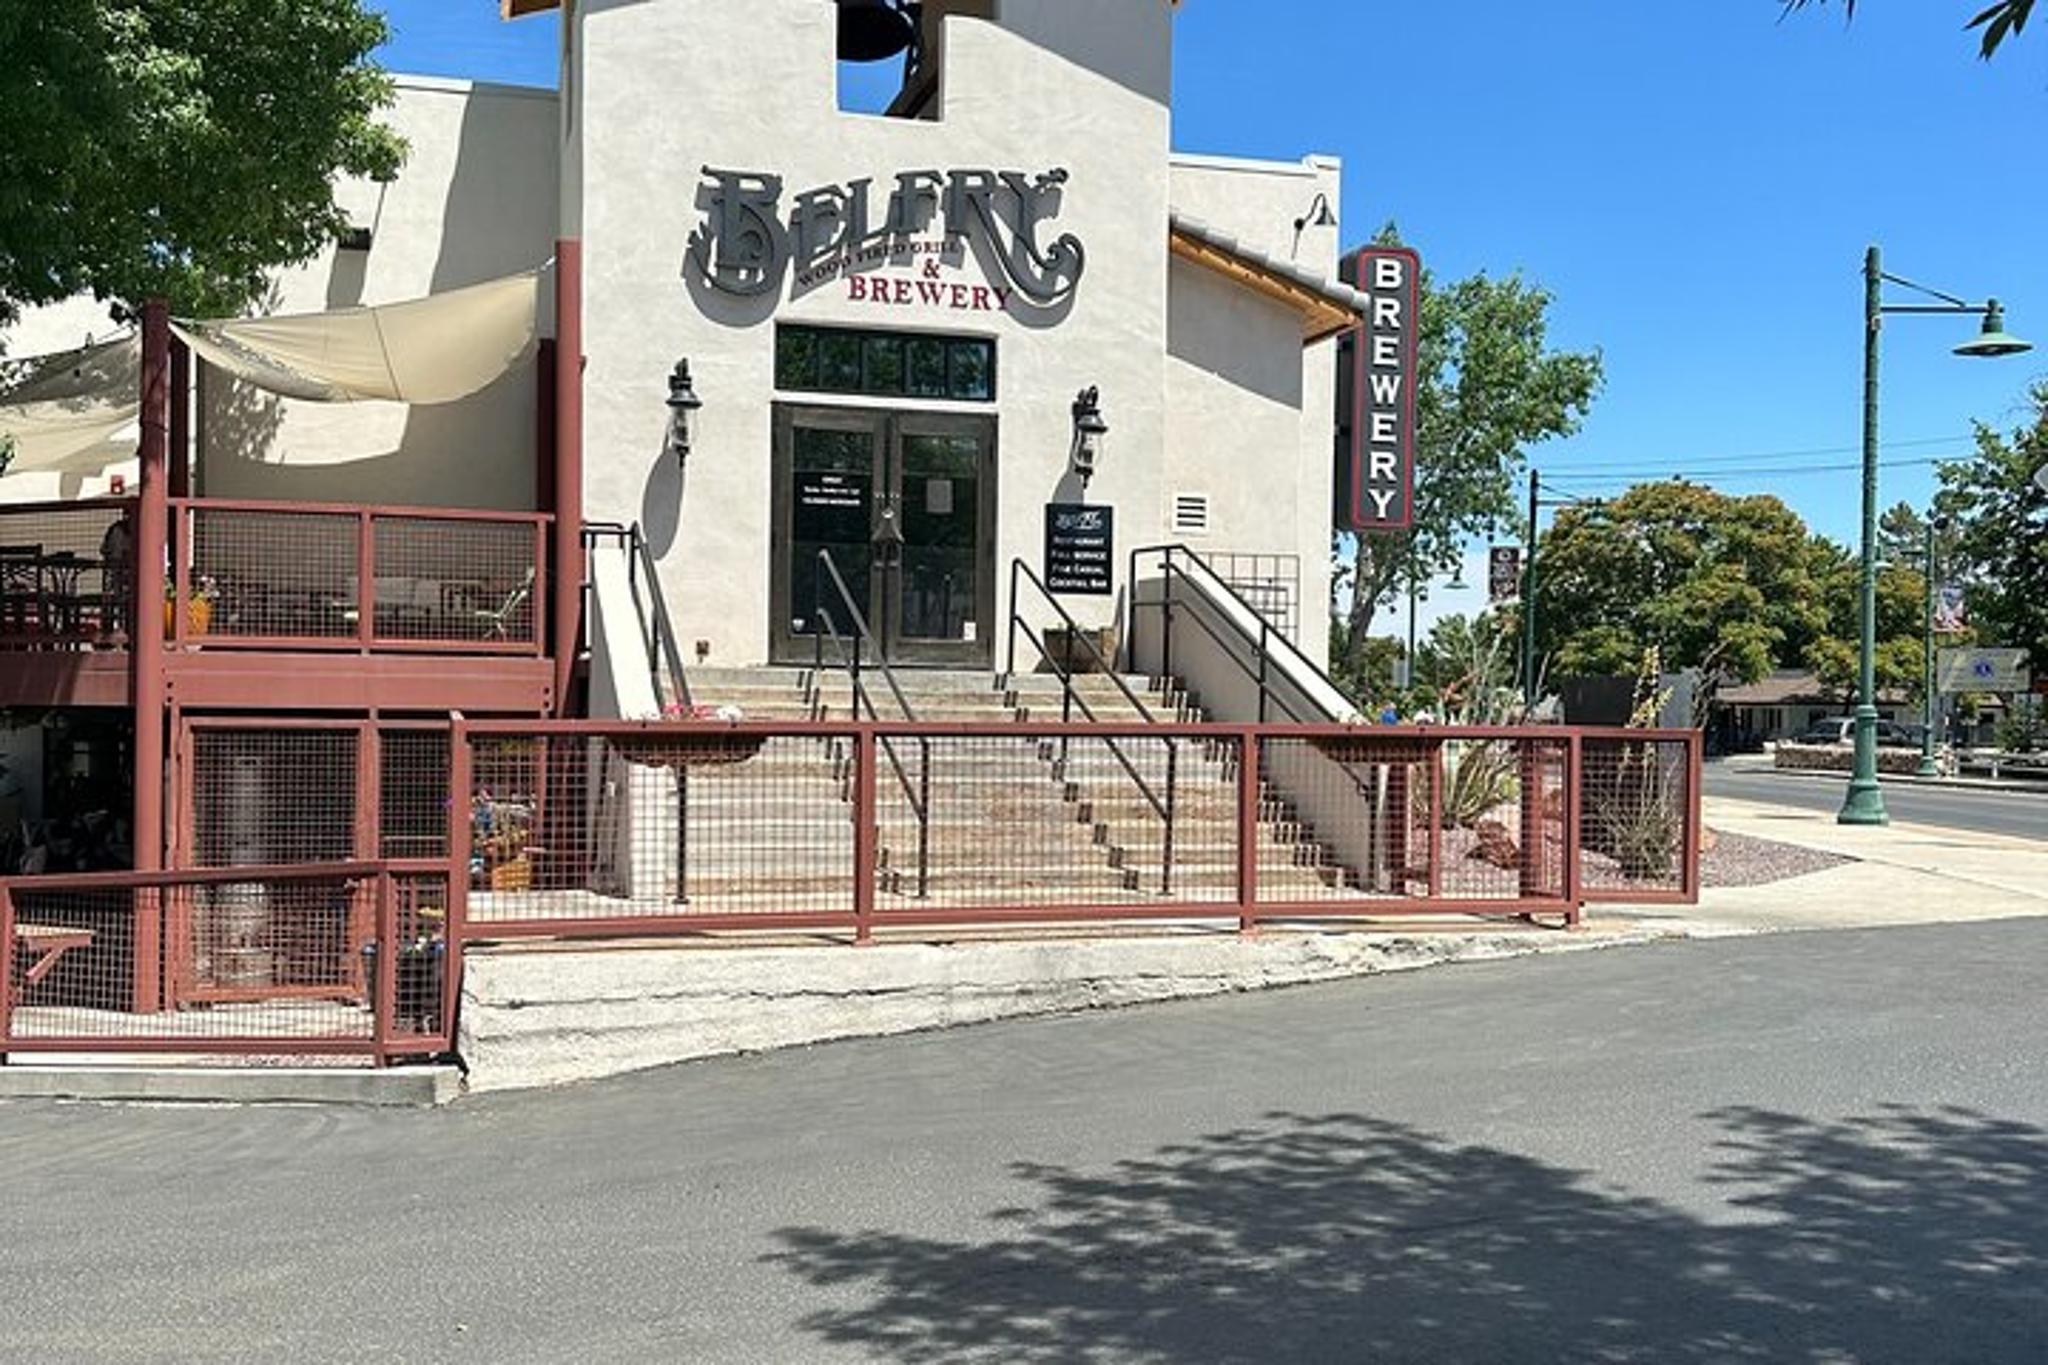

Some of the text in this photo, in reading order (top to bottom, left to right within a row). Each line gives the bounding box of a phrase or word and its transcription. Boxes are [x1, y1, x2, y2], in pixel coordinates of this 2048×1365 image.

[799, 241, 960, 287] WOOD FIRED GRILL
[923, 258, 940, 279] &
[848, 275, 1013, 311] BREWERY
[1368, 258, 1403, 519] BREWERY
